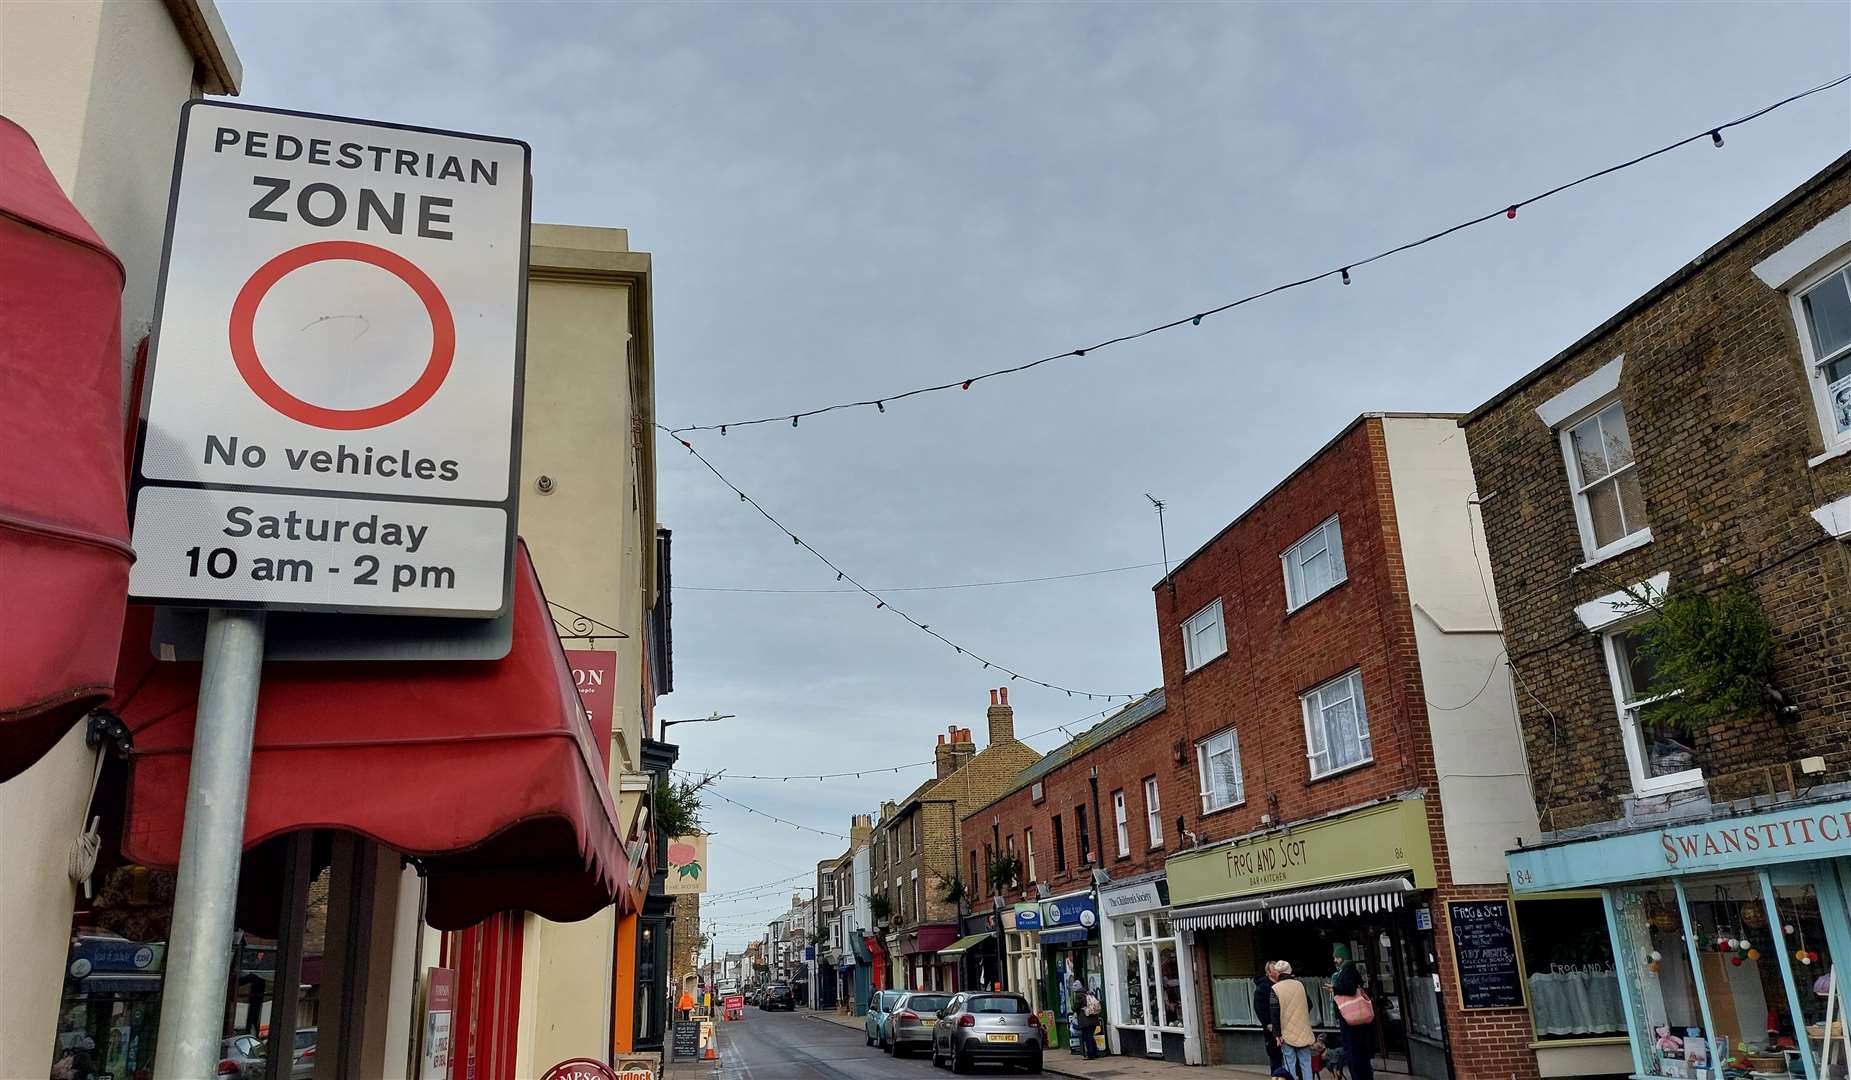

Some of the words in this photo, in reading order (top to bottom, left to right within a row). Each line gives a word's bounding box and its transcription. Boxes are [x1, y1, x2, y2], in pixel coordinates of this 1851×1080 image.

[214, 127, 498, 186] PEDESTRIAN
[248, 176, 454, 241] ZONE
[203, 434, 267, 469] No
[285, 445, 459, 482] vehicles
[222, 506, 429, 552] Saturday
[186, 546, 237, 579] 10
[251, 556, 313, 583] am
[353, 555, 380, 585] 2
[392, 564, 455, 593] pm
[572, 669, 604, 686] ON
[1226, 851, 1254, 878] FROG
[1257, 847, 1276, 872] AND
[1280, 839, 1307, 868] SCOT
[1394, 847, 1404, 859] 86
[1516, 869, 1532, 885] 84
[1109, 897, 1118, 907] The
[1453, 906, 1476, 919] FROG
[1476, 908, 1484, 918] &
[1484, 905, 1503, 917] SCOT
[1550, 962, 1578, 976] FROG
[1582, 962, 1602, 974] AND
[1605, 960, 1616, 975] SC
